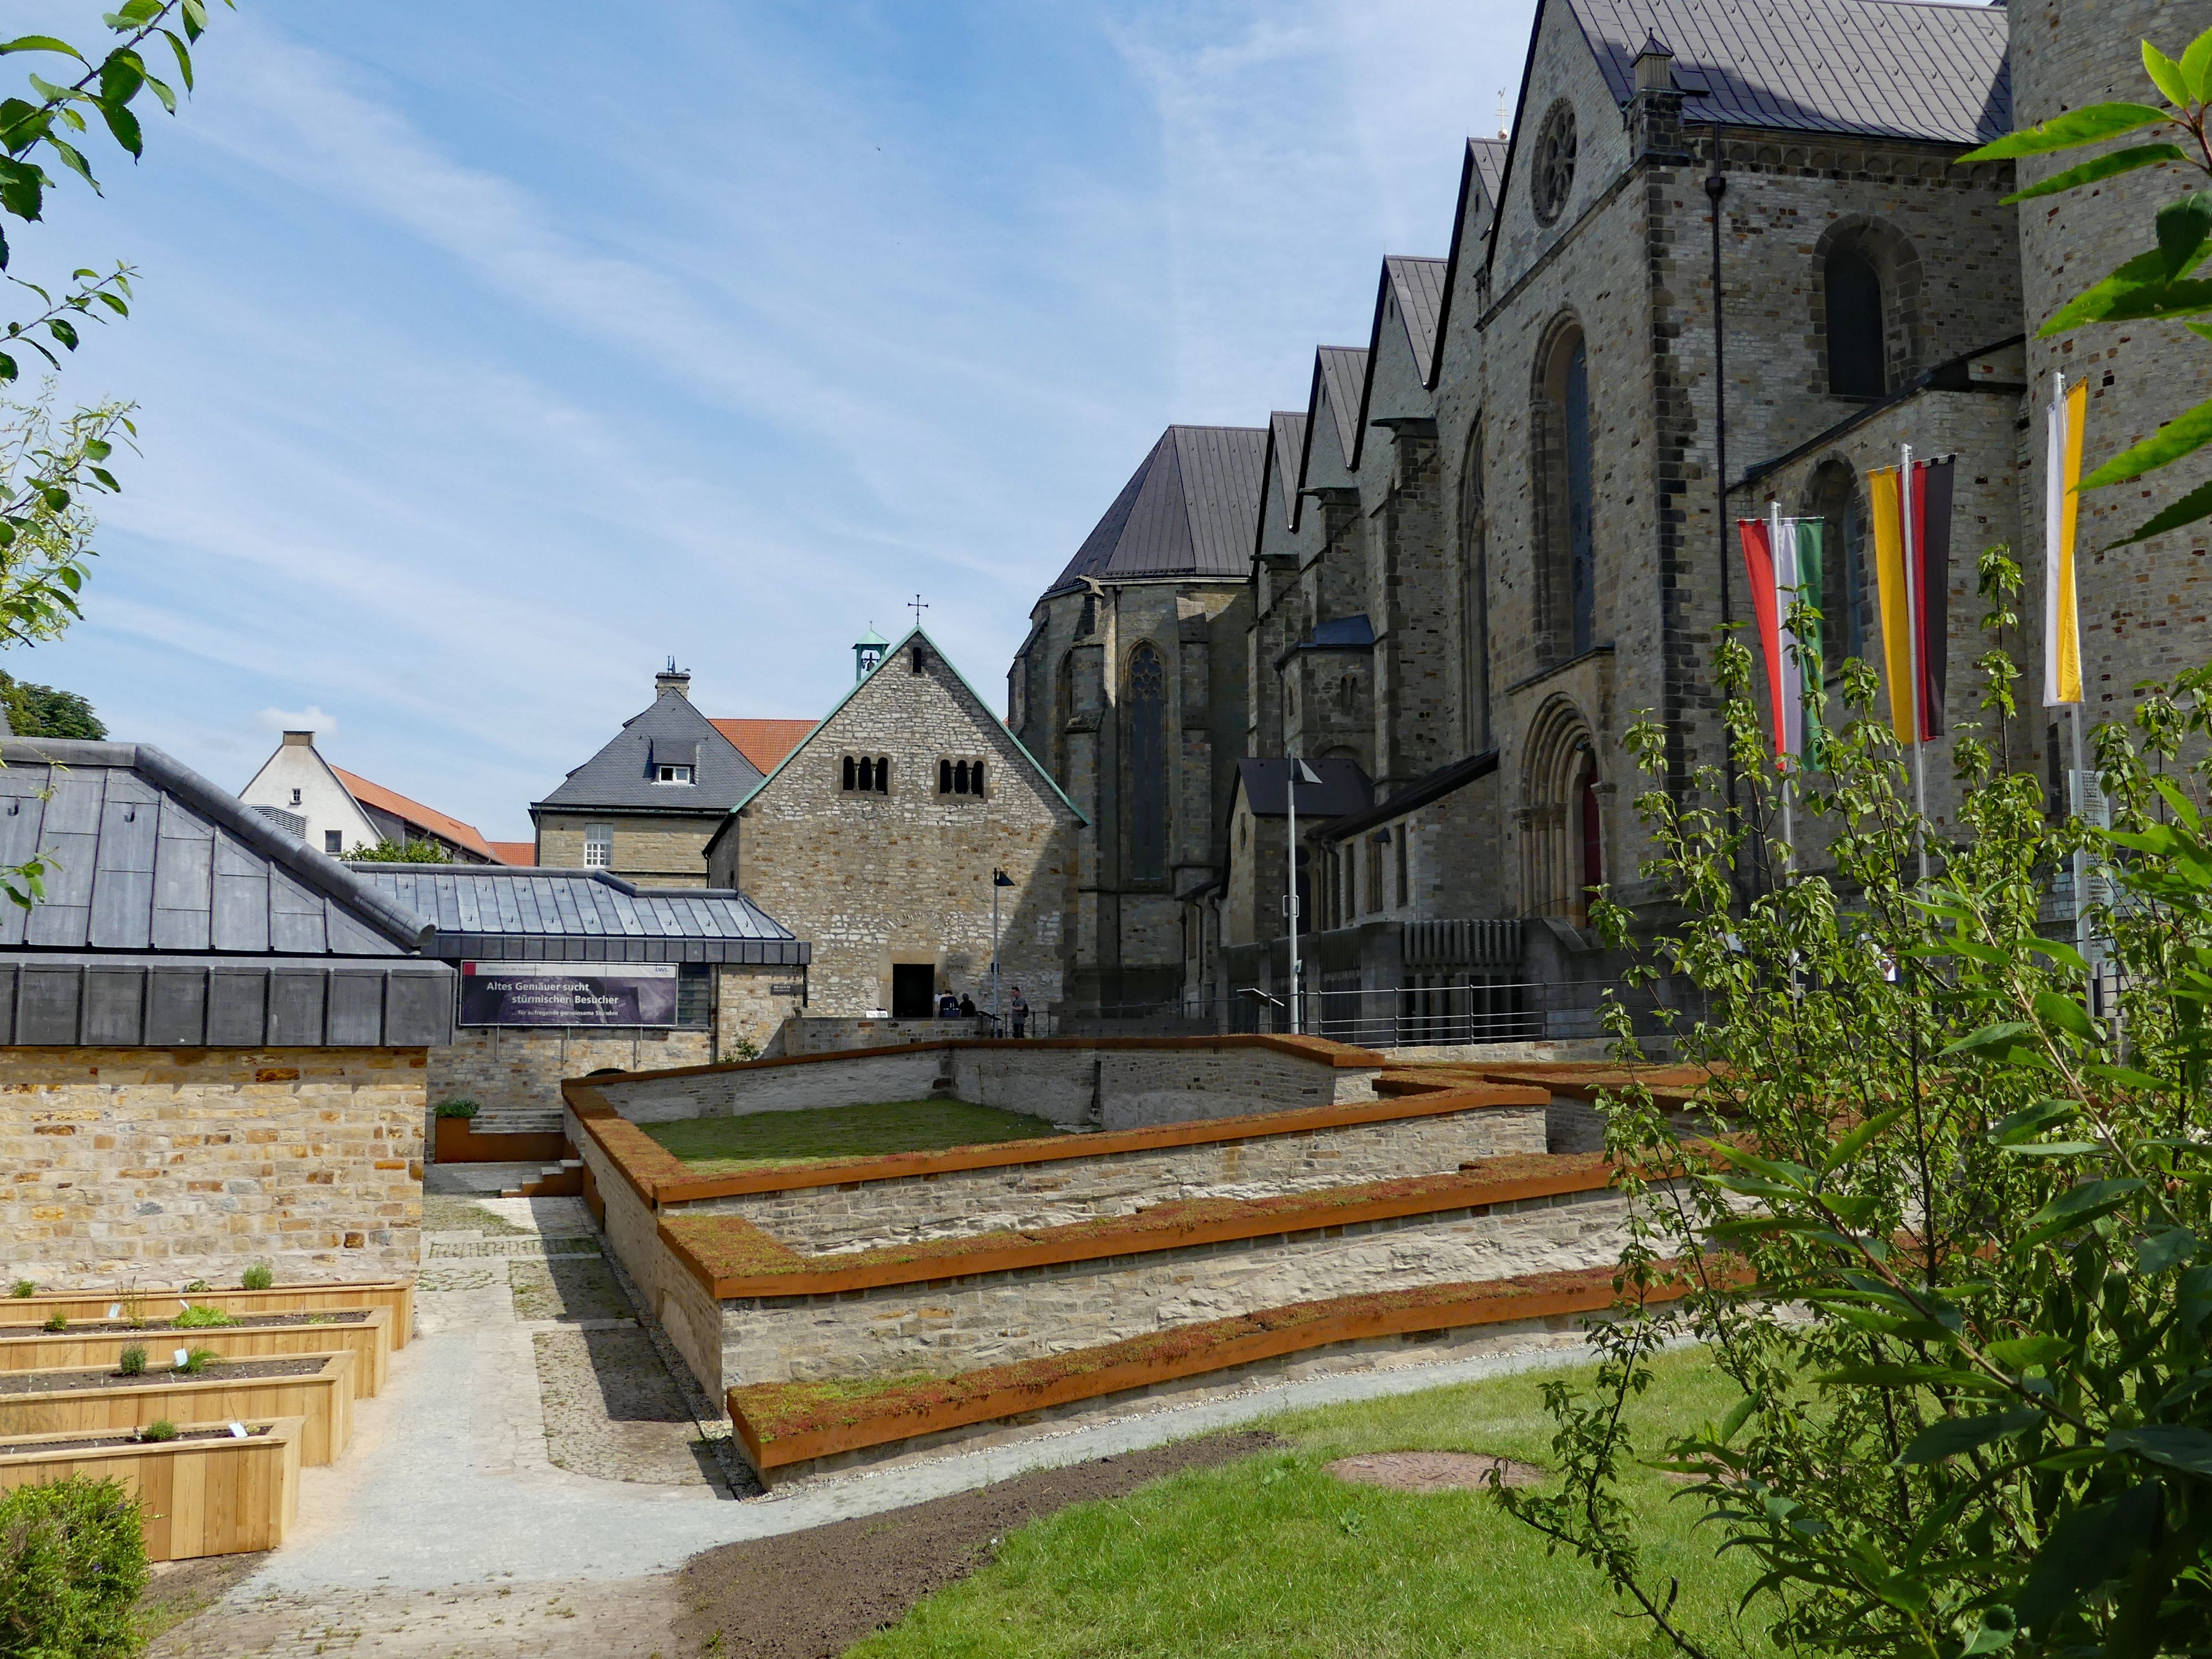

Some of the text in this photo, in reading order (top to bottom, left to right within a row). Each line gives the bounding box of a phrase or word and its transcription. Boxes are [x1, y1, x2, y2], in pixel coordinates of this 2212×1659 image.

[487, 982, 589, 991] Altes Gemäuer sucht
[512, 995, 619, 1004] stürmischen Besucher
